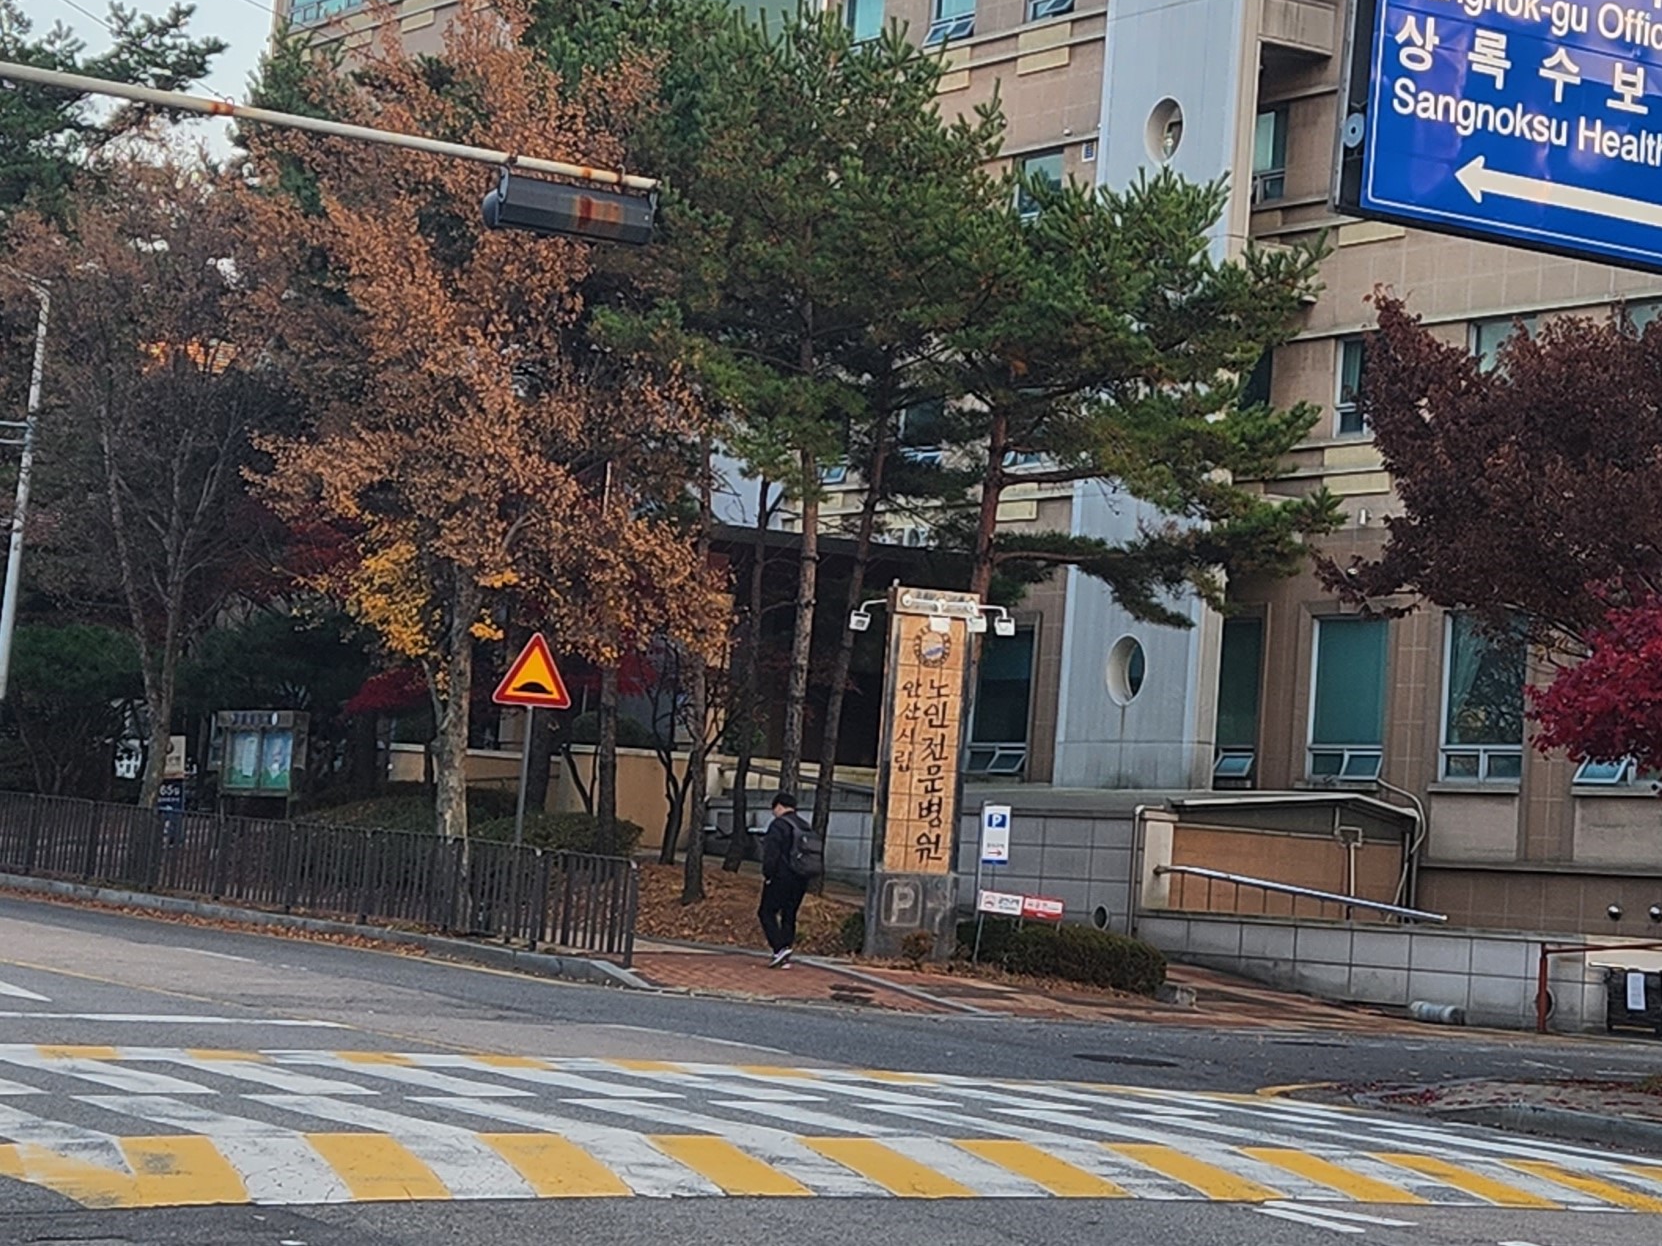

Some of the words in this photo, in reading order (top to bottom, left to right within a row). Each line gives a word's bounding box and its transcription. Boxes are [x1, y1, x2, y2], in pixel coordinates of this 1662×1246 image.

[1392, 77, 1568, 147] Sangnoksu
[894, 679, 922, 773] 안산시립
[914, 678, 950, 863] 노인전문병원
[991, 814, 1004, 828] P
[891, 885, 916, 924] P
